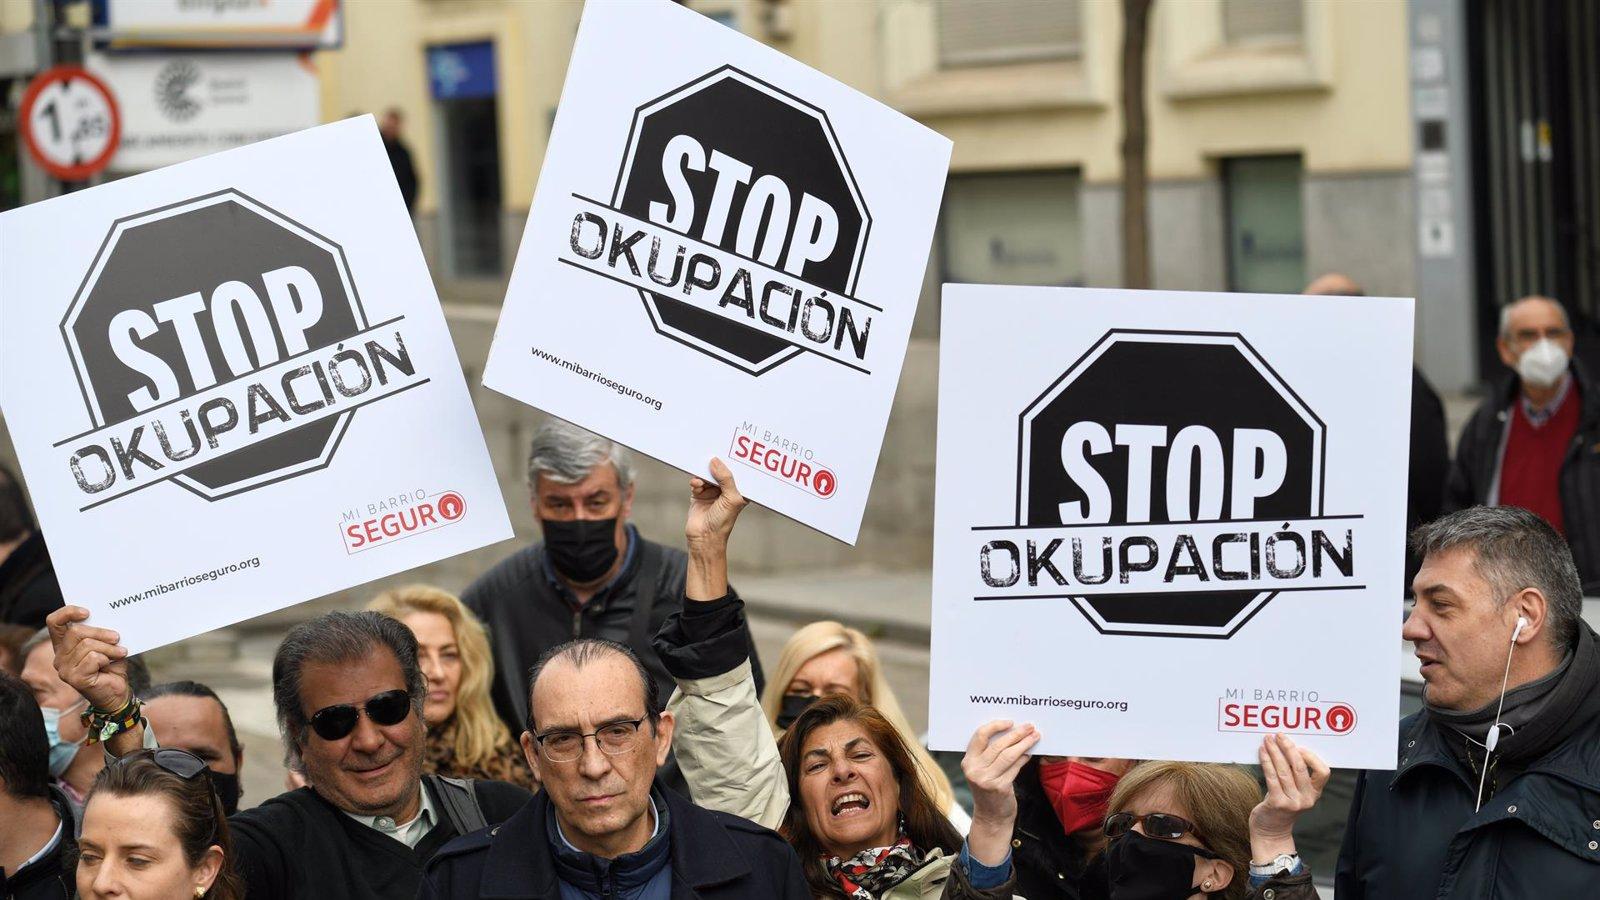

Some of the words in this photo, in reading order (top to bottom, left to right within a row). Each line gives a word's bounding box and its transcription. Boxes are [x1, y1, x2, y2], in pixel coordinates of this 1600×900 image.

[648, 134, 839, 278] STOP
[569, 211, 873, 361] OKUPACIÓN
[107, 265, 324, 412] STOP
[531, 346, 663, 411] www.mibarrioseguro.org
[69, 331, 416, 494] OKUPACIÓN
[742, 421, 758, 436] MI
[763, 430, 814, 461] BARRIO
[1058, 420, 1288, 525] STOP
[342, 507, 361, 522] MI
[367, 489, 426, 515] BARRIO
[109, 556, 261, 609] www.mibarrioseguro.org
[979, 522, 1354, 588] OKUPACIÓN
[969, 694, 1129, 712] www.mibarrioseguro.org
[1225, 687, 1244, 700] MI
[1254, 689, 1319, 703] BARRIO
